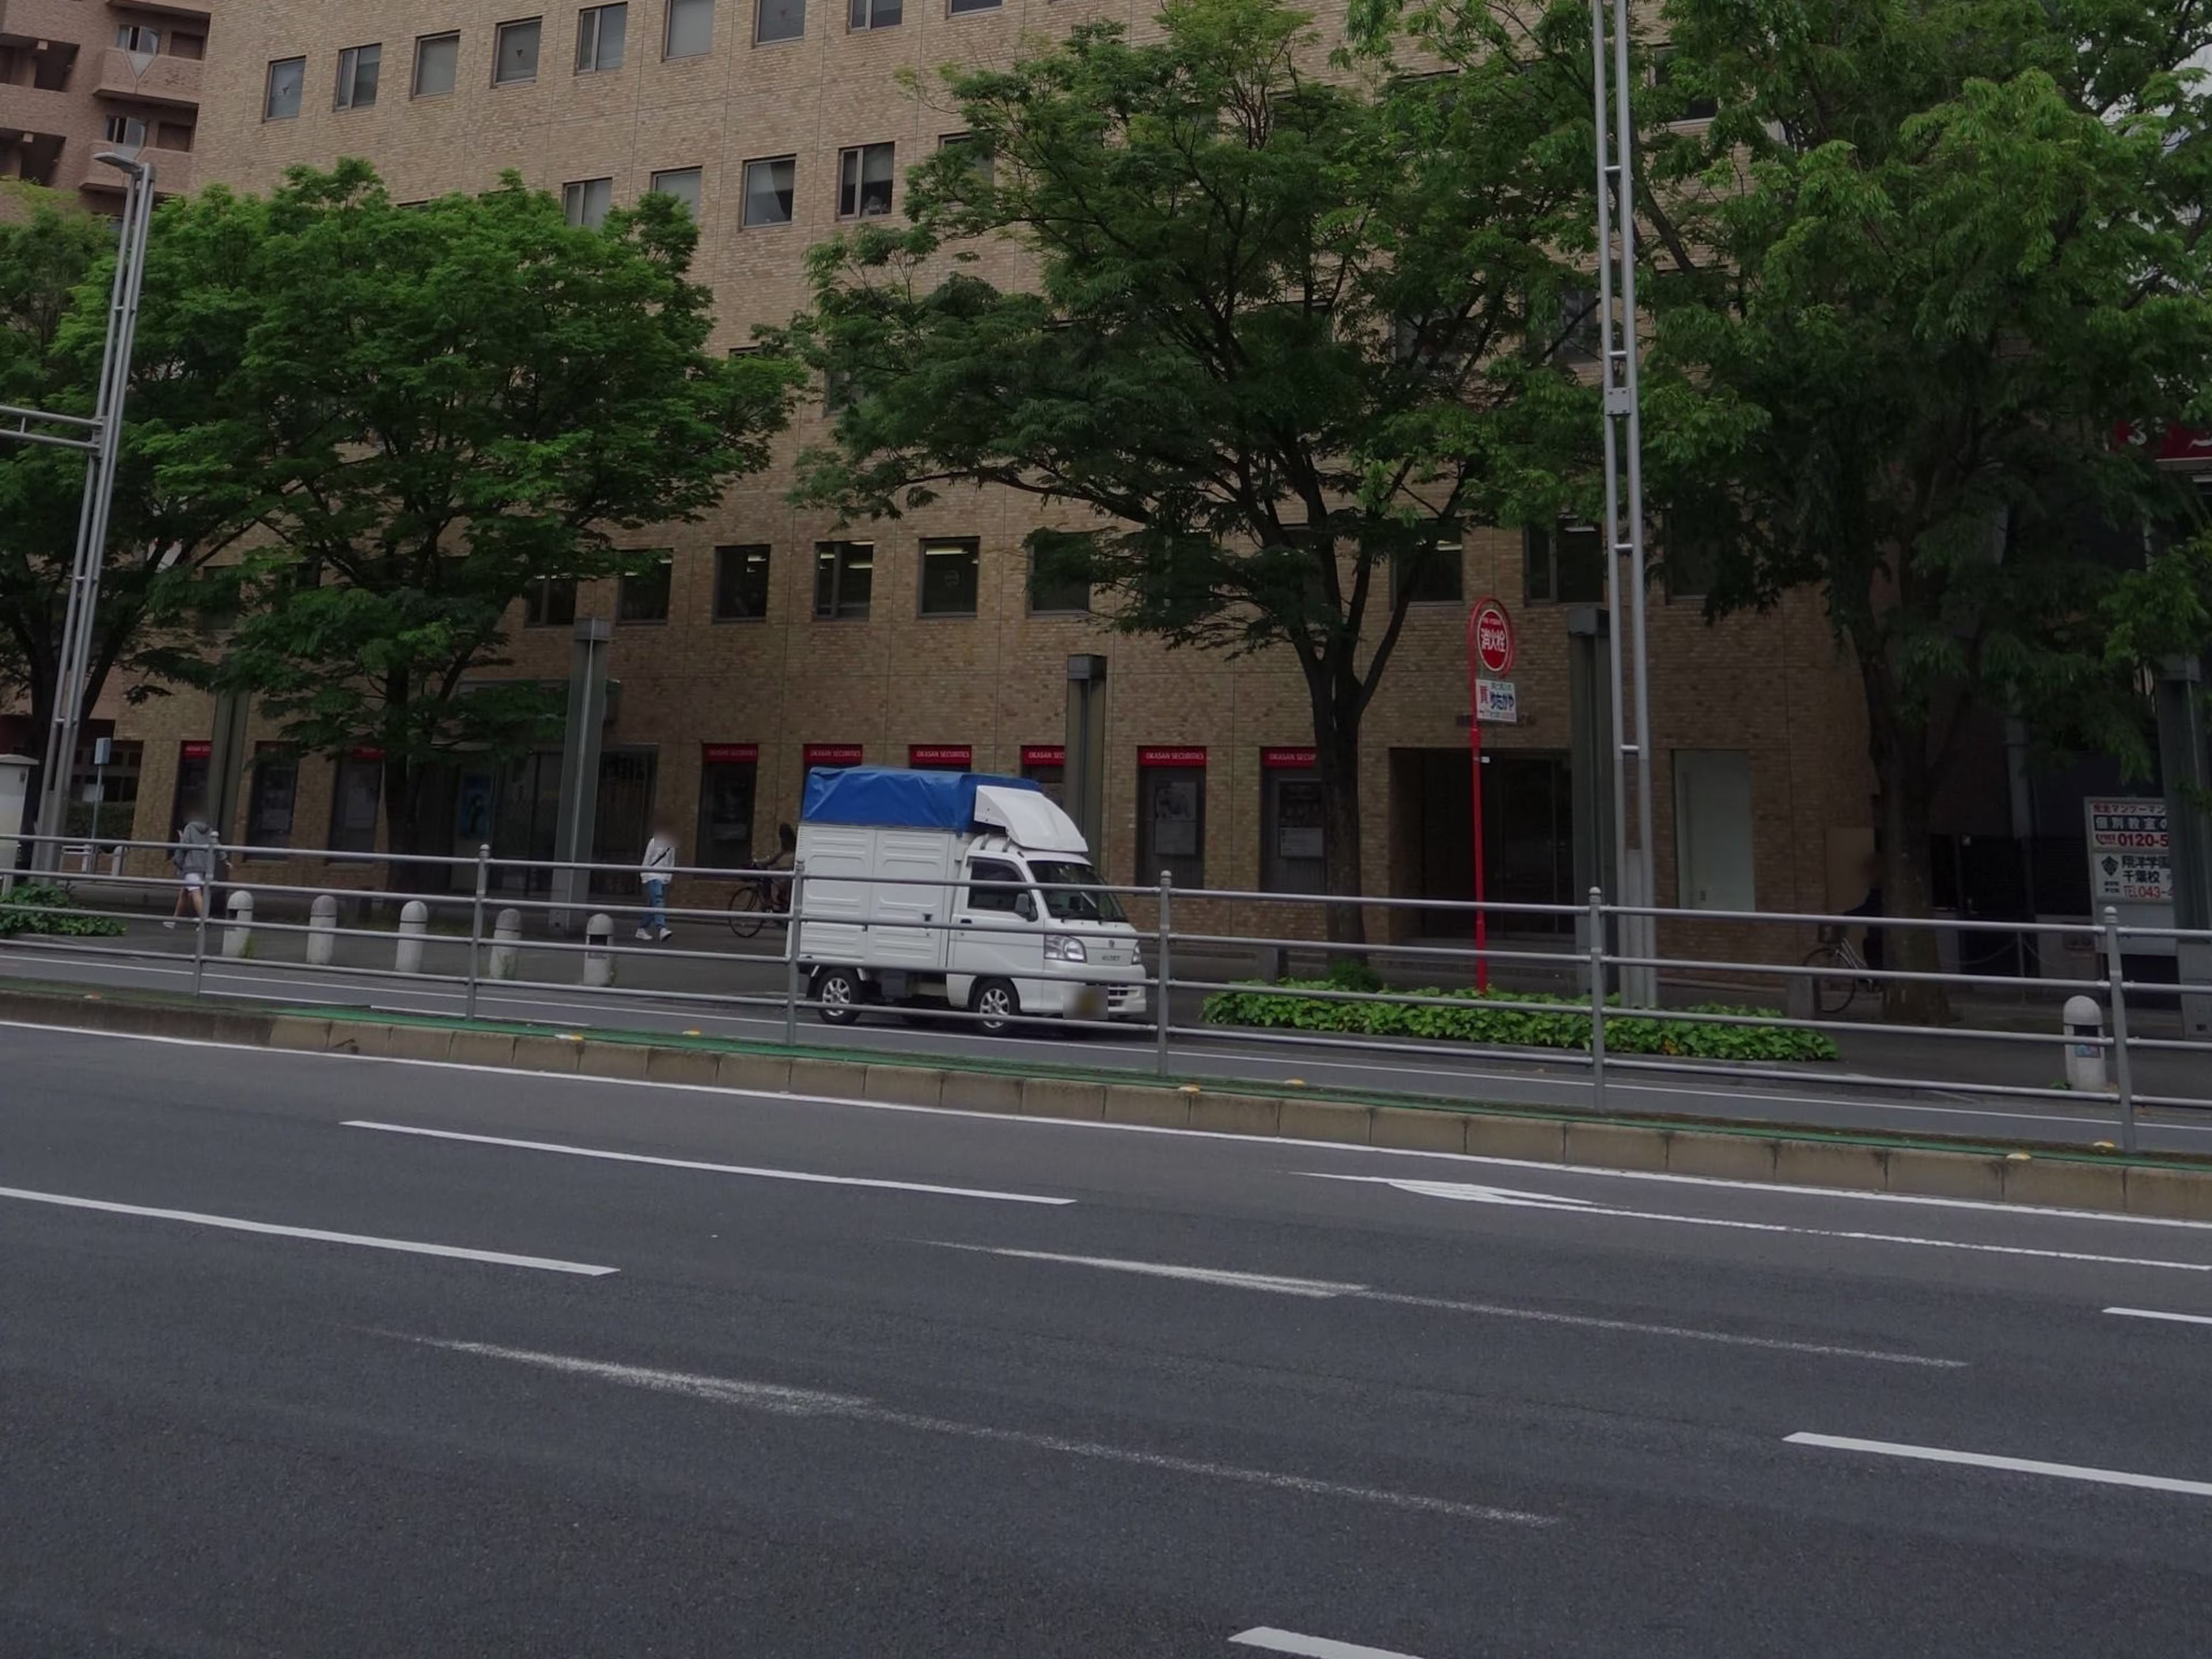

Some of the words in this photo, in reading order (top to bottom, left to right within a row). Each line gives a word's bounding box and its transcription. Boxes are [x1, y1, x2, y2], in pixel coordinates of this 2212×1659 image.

[1480, 627, 1506, 652] 消火栓
[2122, 870, 2160, 883] 千葉校
